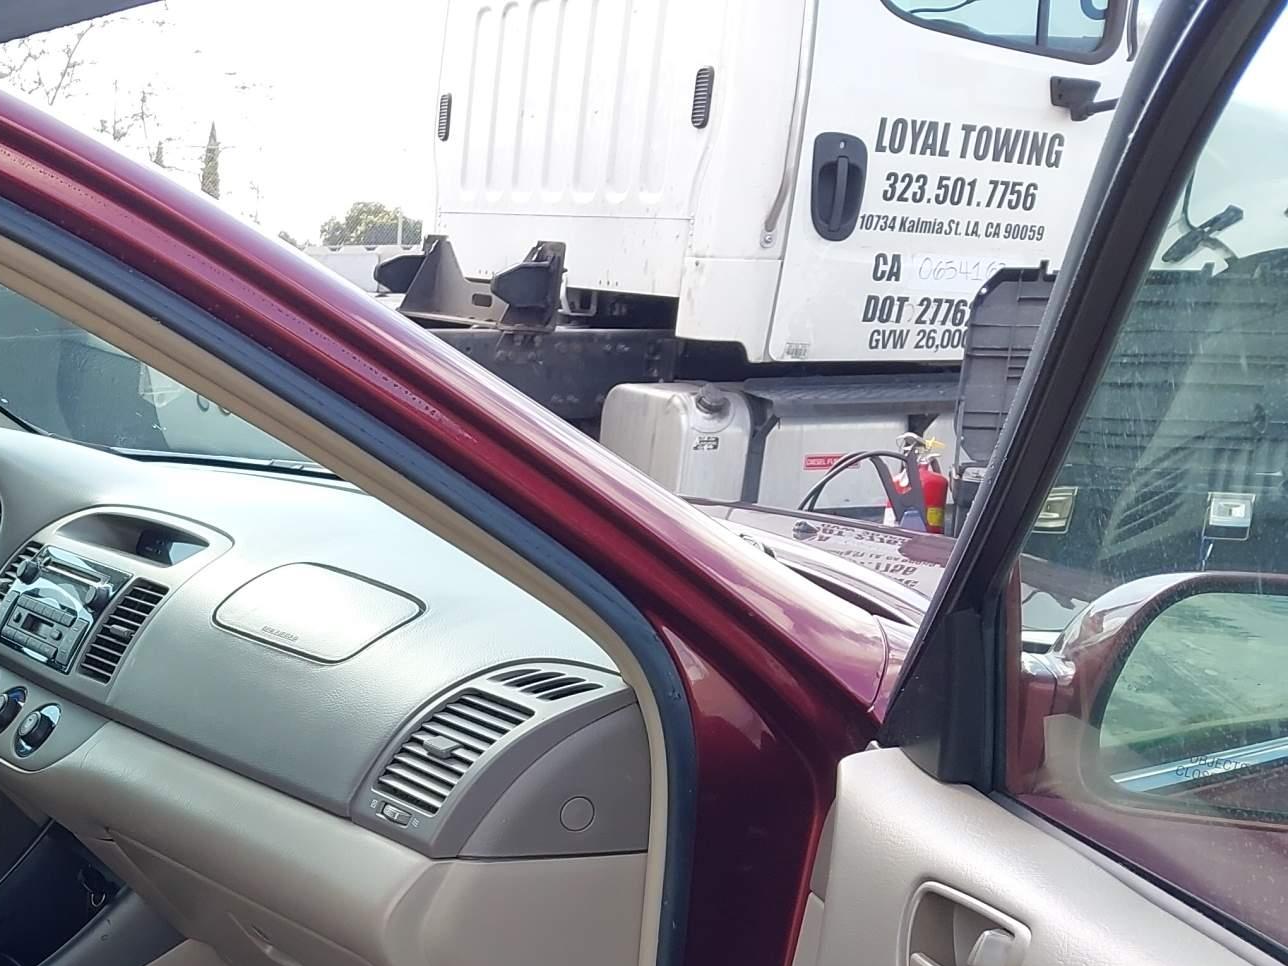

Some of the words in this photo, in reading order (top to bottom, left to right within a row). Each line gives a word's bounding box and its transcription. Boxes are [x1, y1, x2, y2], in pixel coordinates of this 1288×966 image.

[875, 117, 951, 157] LOYAL
[960, 124, 1065, 168] TOWING
[882, 172, 1038, 211] 323.501.7756
[859, 214, 897, 231] 10734
[898, 216, 944, 234] Kalmia
[944, 219, 962, 236] St.
[984, 222, 1001, 239] CA
[1003, 223, 1045, 241] 90059
[872, 253, 901, 282] CA
[862, 295, 910, 323] DOT
[914, 297, 971, 327] 2776
[868, 329, 910, 349] GVW
